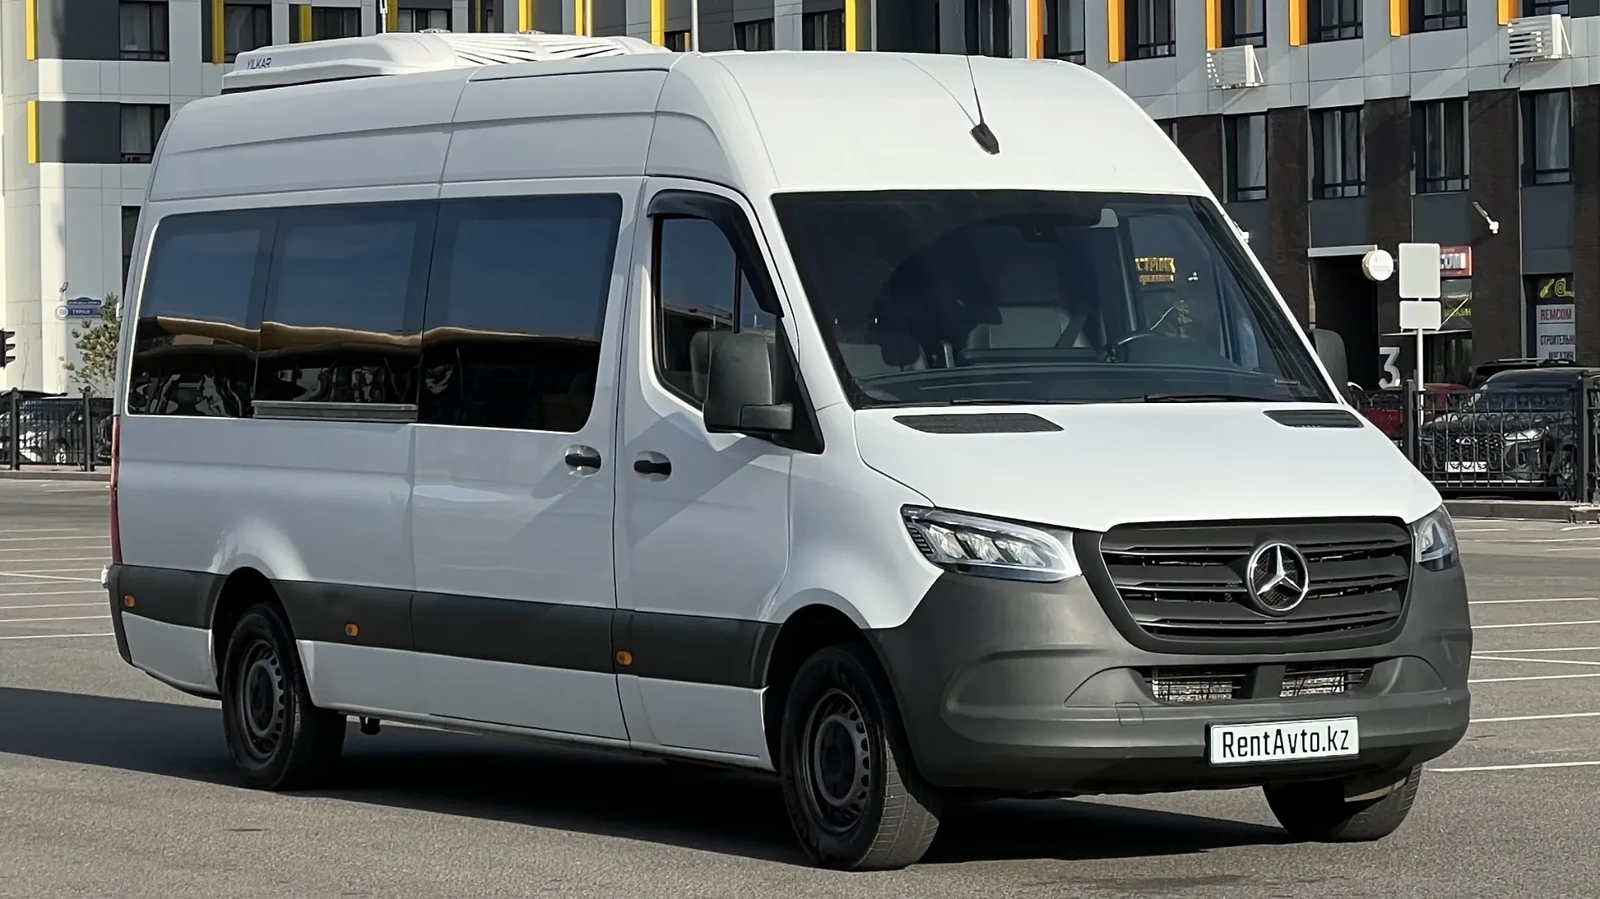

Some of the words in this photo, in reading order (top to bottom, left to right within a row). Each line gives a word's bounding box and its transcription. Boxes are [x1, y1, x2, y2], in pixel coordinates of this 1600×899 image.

[1540, 309, 1572, 320] REMCOM
[1379, 347, 1401, 390] 3
[1222, 725, 1350, 758] RentAvto.kz
